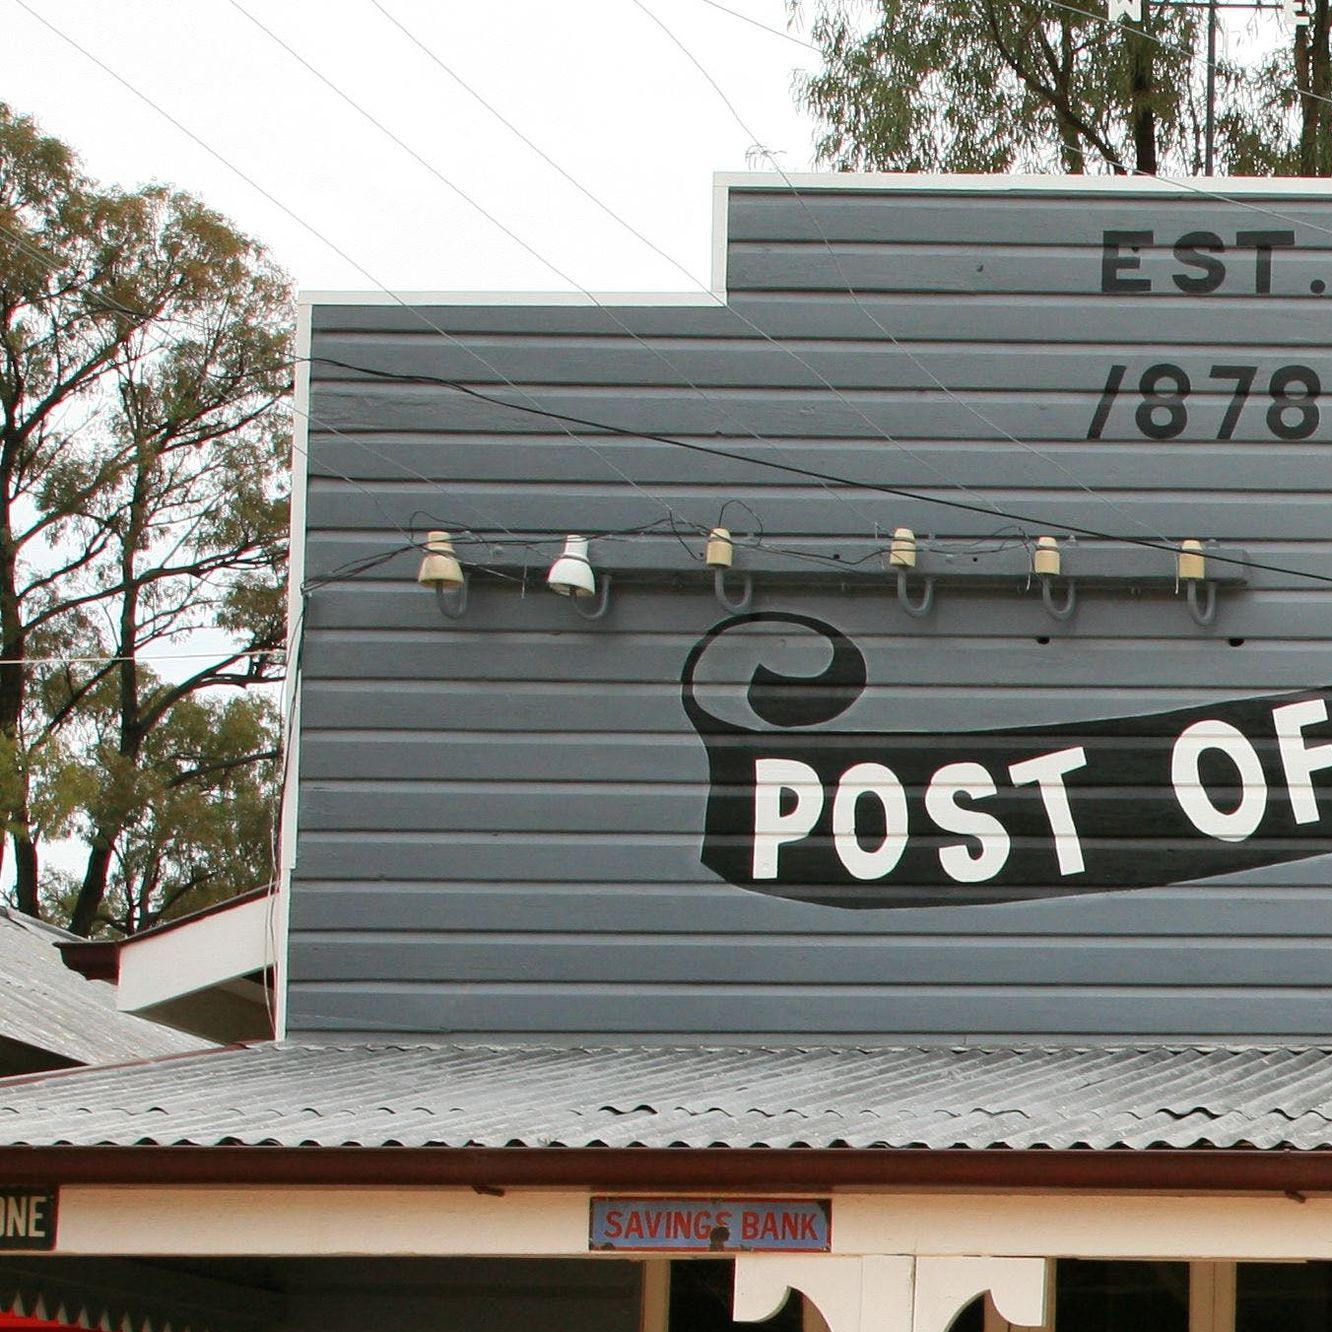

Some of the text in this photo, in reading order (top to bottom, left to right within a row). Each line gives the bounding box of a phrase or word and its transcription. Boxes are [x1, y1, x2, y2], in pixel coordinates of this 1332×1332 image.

[1101, 230, 1326, 294] EST.
[1086, 363, 1321, 440] 1878
[751, 745, 1087, 883] POST
[604, 1211, 819, 1241] SAVINGS BANK
